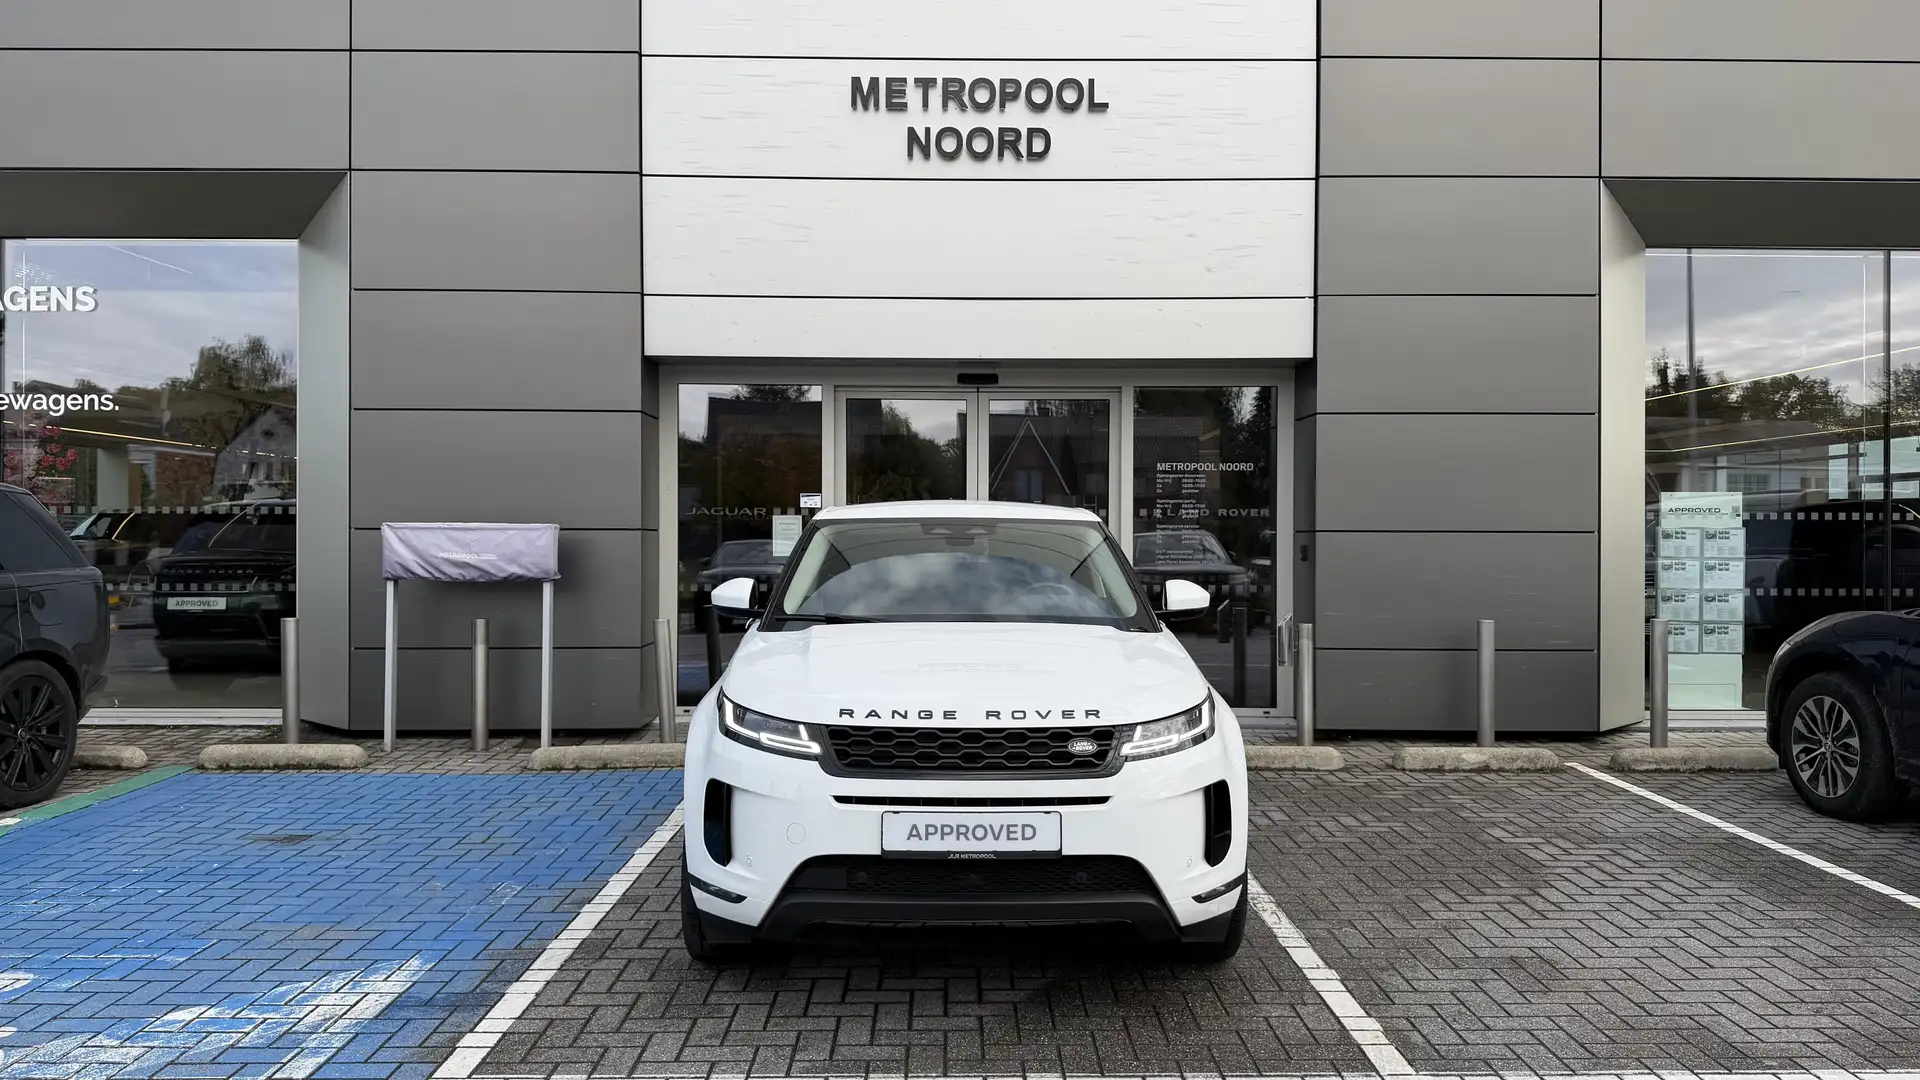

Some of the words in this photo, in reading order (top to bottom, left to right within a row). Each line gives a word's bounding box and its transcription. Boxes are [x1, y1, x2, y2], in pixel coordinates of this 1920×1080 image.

[850, 76, 1109, 112] METROPOOL
[907, 126, 1052, 161] NOORD
[1156, 462, 1217, 471] METROPOOL
[1219, 462, 1254, 471] NOORD
[685, 507, 767, 516] JAGUAR
[175, 600, 219, 608] APPROVED
[839, 708, 957, 720] RANGE
[985, 709, 1101, 720] ROVER
[906, 823, 1037, 841] APPROVED
